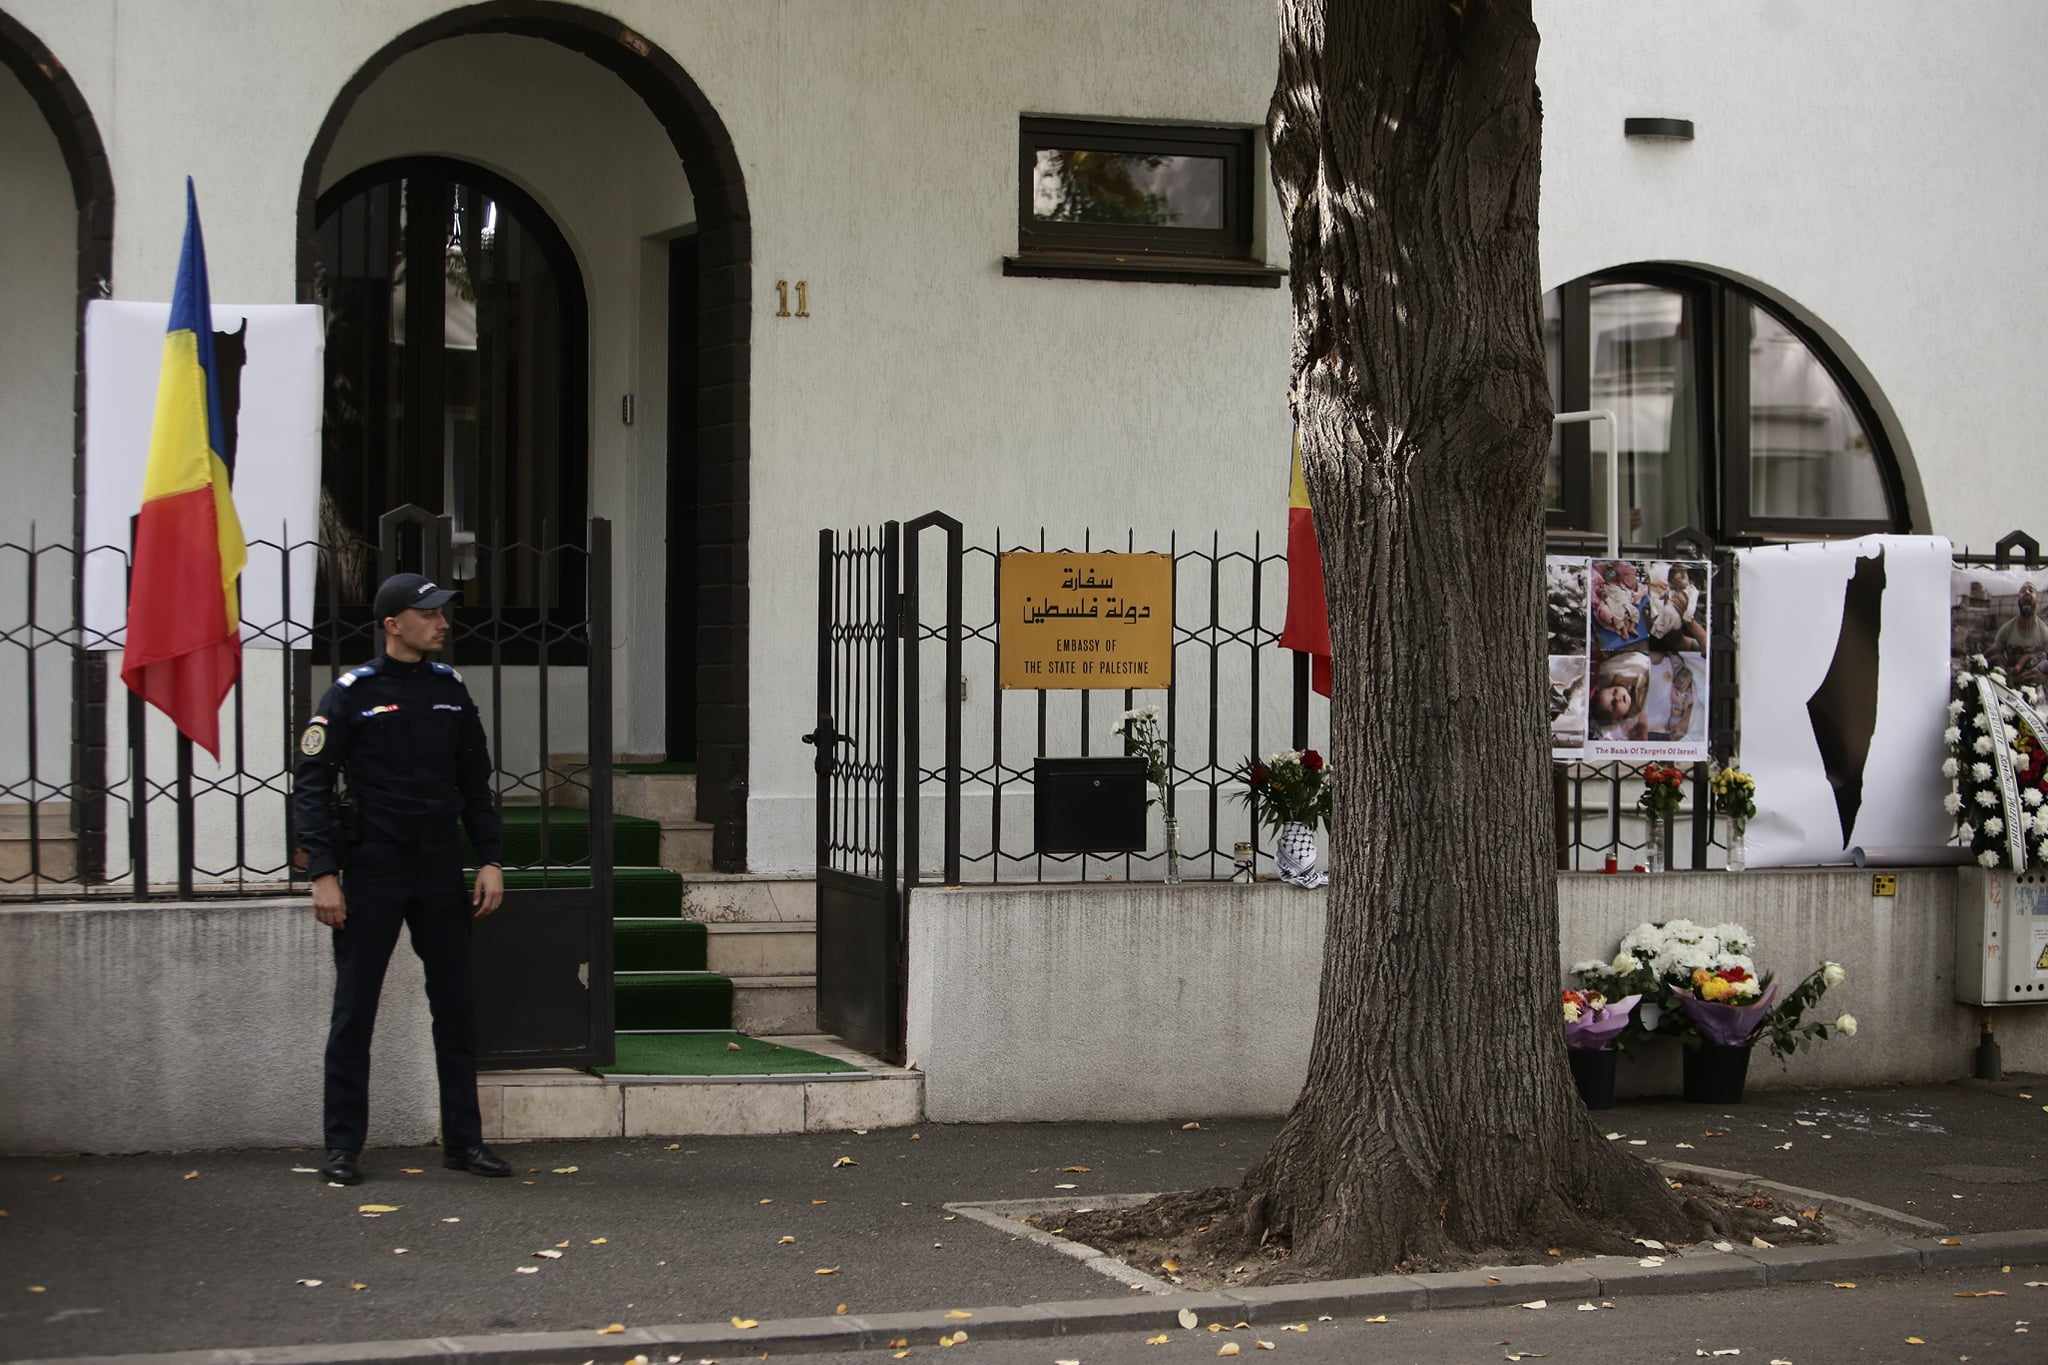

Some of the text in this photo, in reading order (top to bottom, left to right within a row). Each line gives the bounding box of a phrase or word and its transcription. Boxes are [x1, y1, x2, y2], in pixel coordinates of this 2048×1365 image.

[776, 280, 809, 317] 11
[1061, 568, 1113, 591] سفارة
[1023, 597, 1150, 624] دولة فلسطين
[1056, 639, 1117, 652] EMBASSY OF
[1024, 660, 1149, 674] THE STATE OF PALESTINE
[1640, 747, 1666, 756] Targets
[1667, 747, 1676, 755] Of
[1677, 747, 1698, 755] Israel
